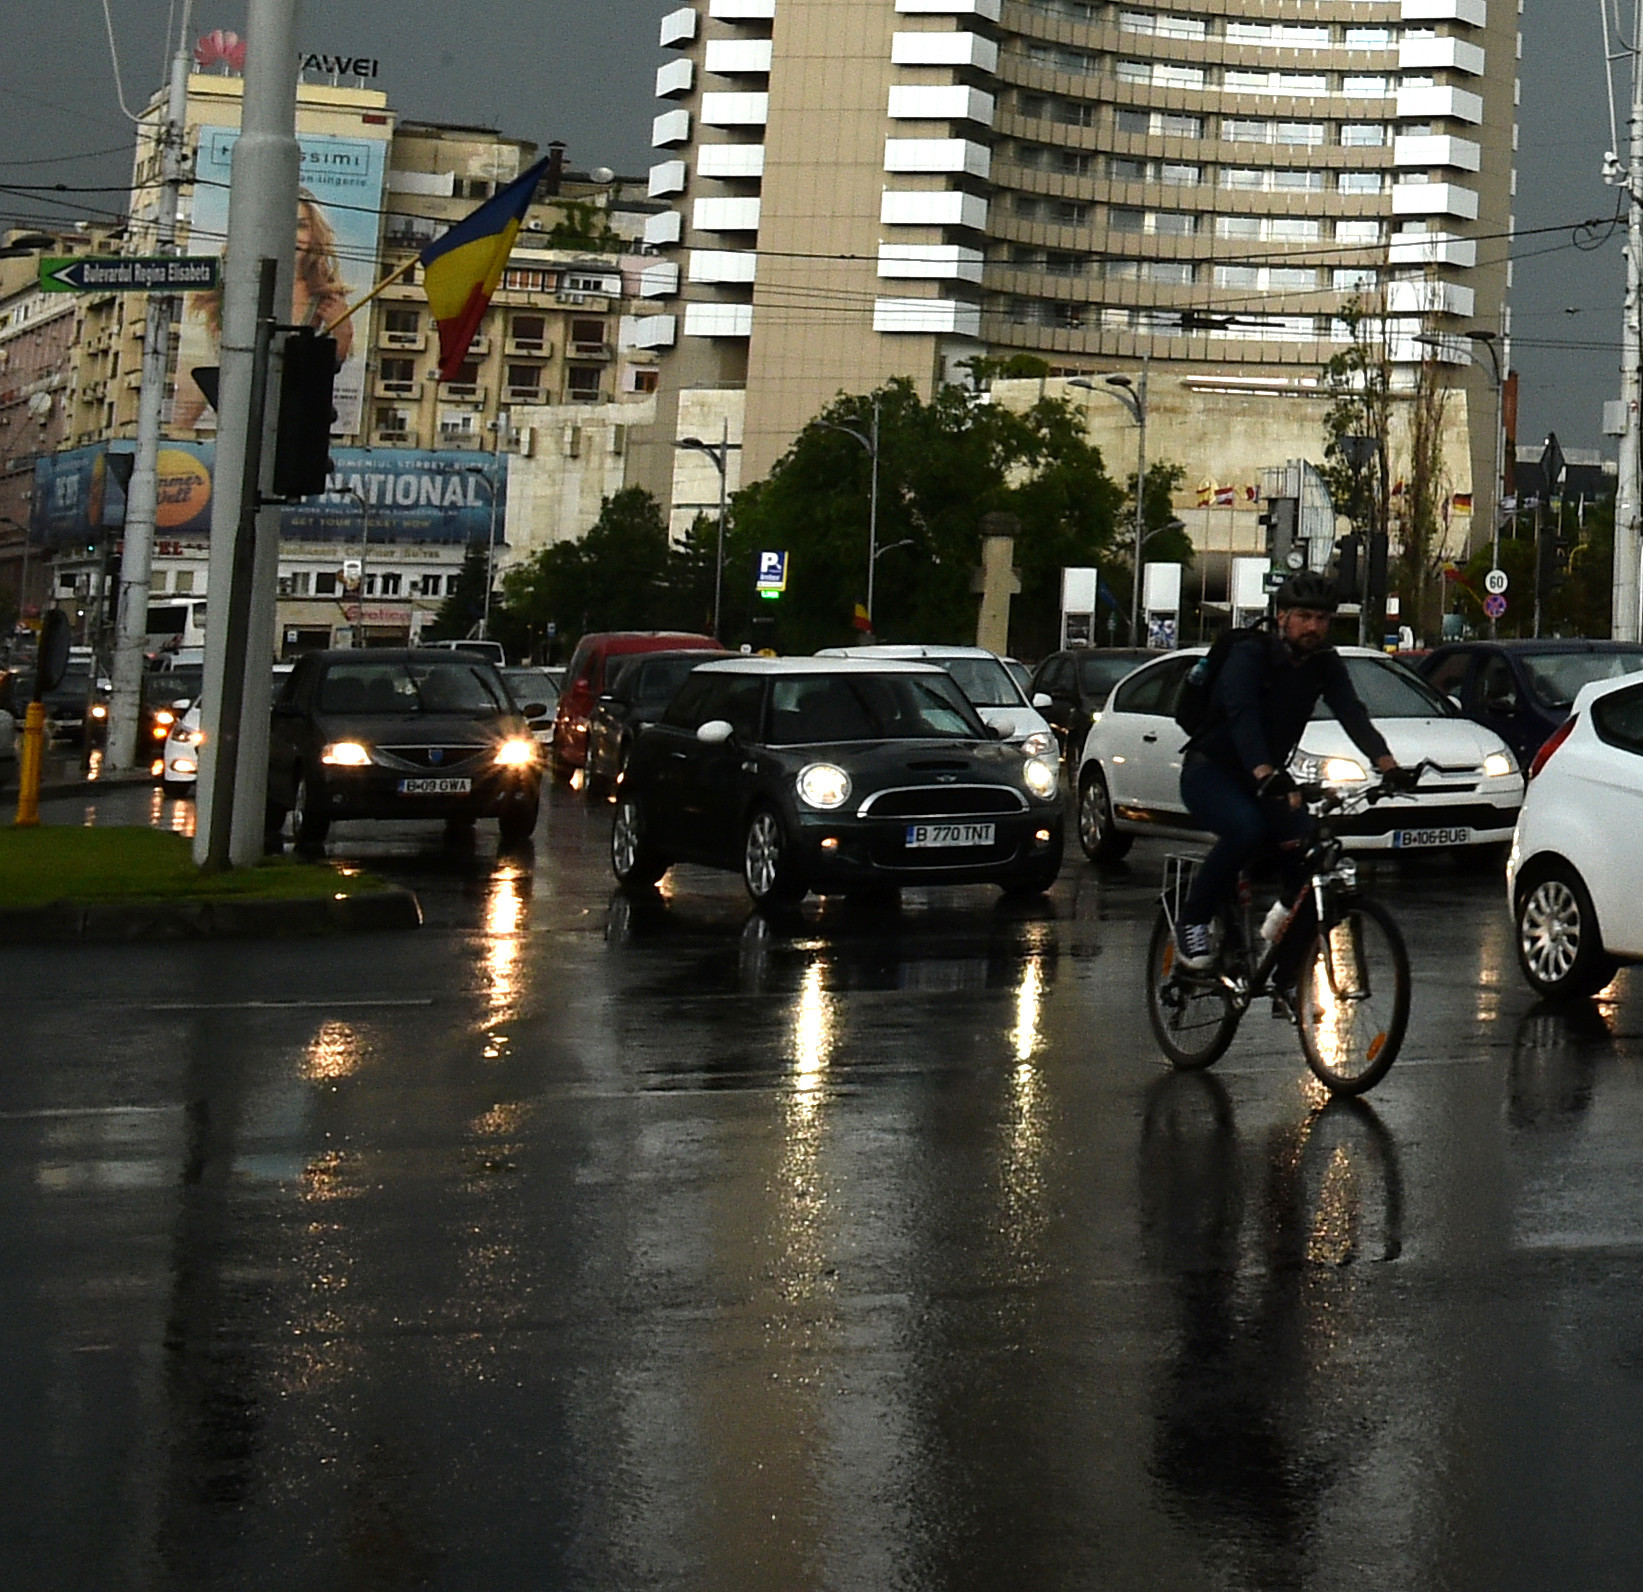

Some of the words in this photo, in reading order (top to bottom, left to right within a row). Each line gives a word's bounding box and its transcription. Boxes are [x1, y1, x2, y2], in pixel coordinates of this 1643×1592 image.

[299, 53, 379, 78] AWEI
[83, 263, 132, 283] Bulevardul
[134, 263, 165, 287] Regina
[168, 262, 210, 282] Elisabeta
[319, 473, 483, 507] NATIONAL
[760, 551, 779, 573] P
[1489, 575, 1504, 589] 60
[916, 828, 927, 842] B
[933, 827, 960, 842] 770
[964, 825, 991, 841] TNT
